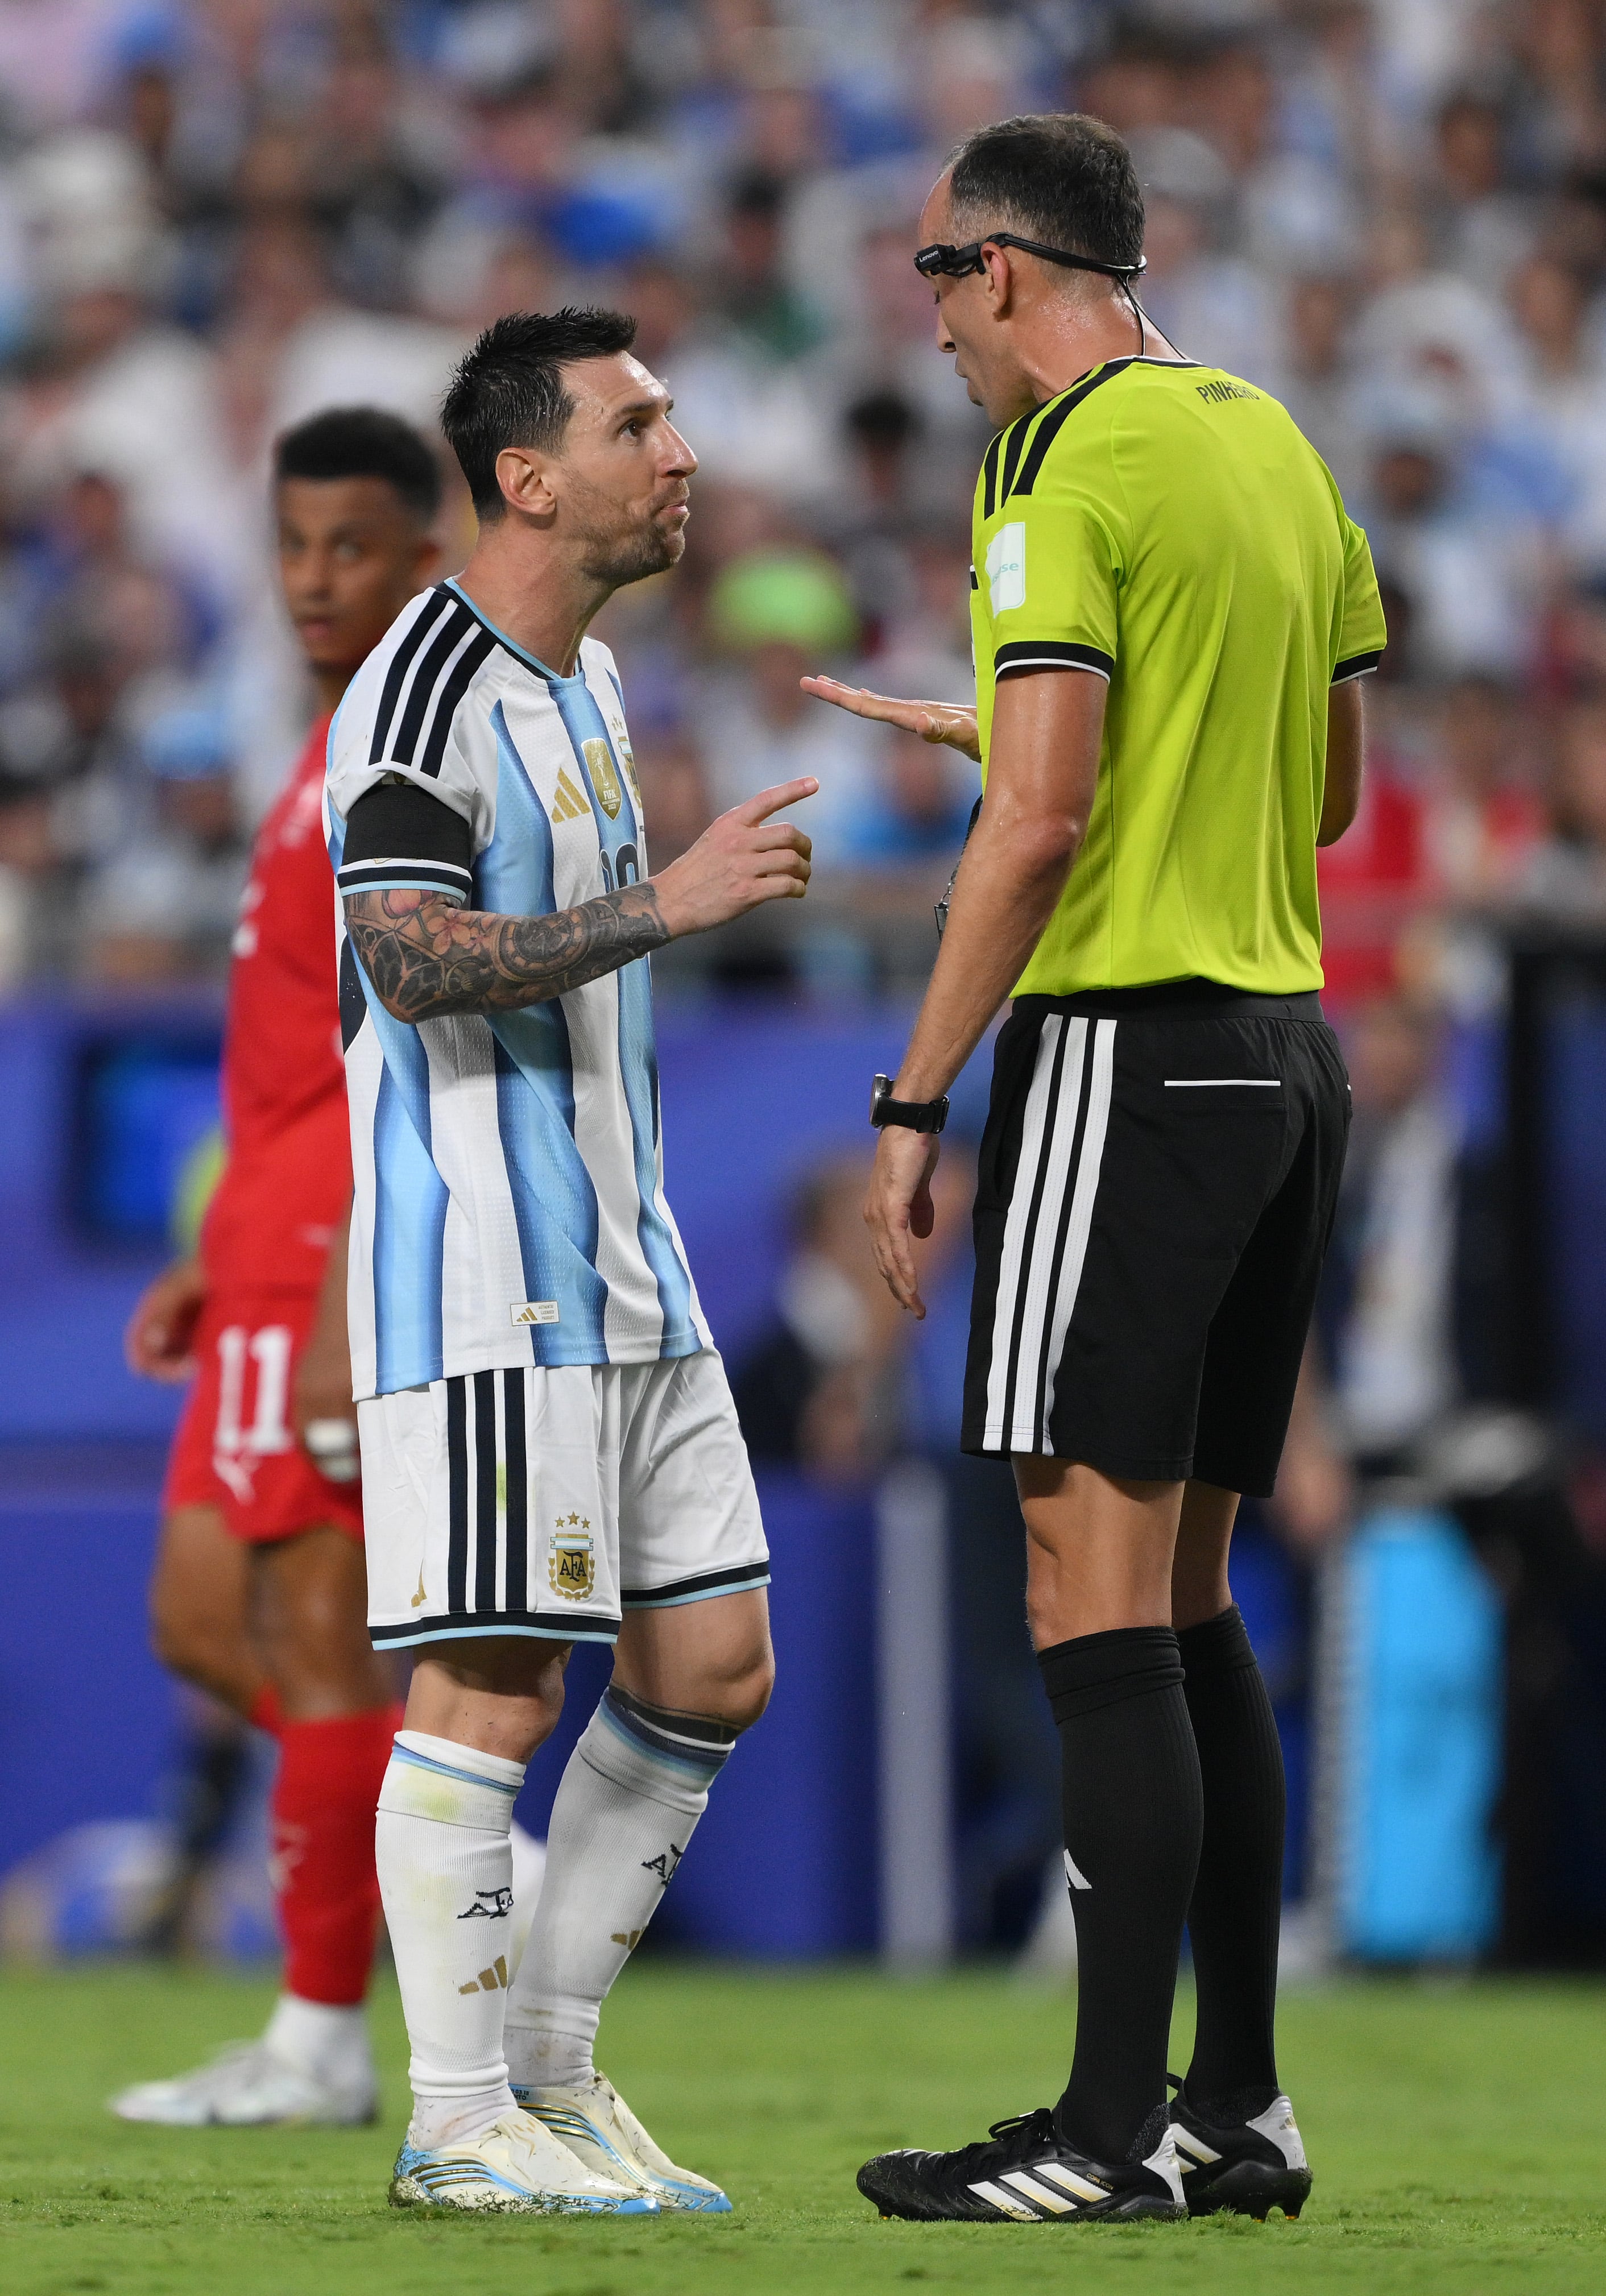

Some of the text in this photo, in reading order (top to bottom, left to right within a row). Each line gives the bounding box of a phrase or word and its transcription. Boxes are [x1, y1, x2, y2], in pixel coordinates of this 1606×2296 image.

[919, 251, 938, 262] Lenovo
[603, 789, 616, 800] FIFA
[214, 1324, 293, 1455] 11
[560, 1551, 586, 1581] AFA
